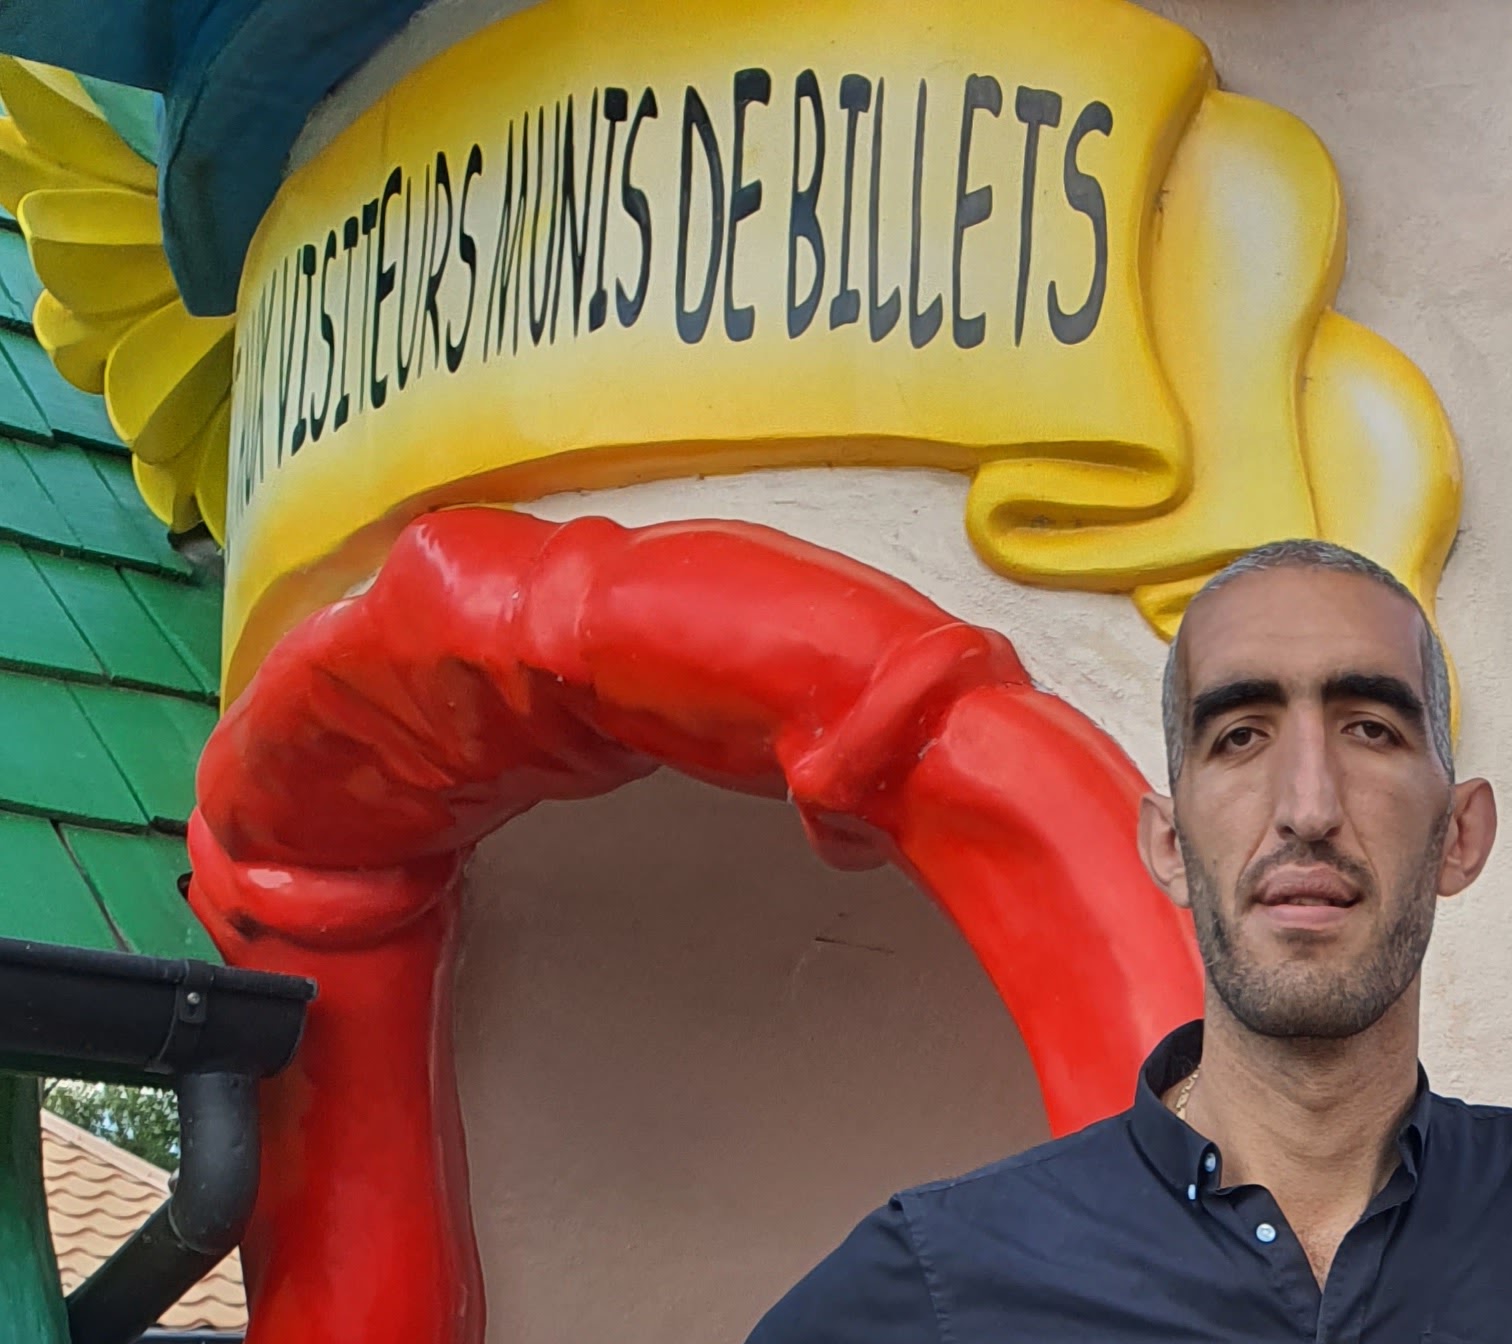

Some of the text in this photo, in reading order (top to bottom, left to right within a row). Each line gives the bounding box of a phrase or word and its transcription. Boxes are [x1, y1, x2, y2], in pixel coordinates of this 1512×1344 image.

[277, 143, 483, 468] VISITEURS
[482, 85, 659, 364] MUNIS
[676, 68, 771, 345] DE
[787, 68, 1113, 349] BILLETS
